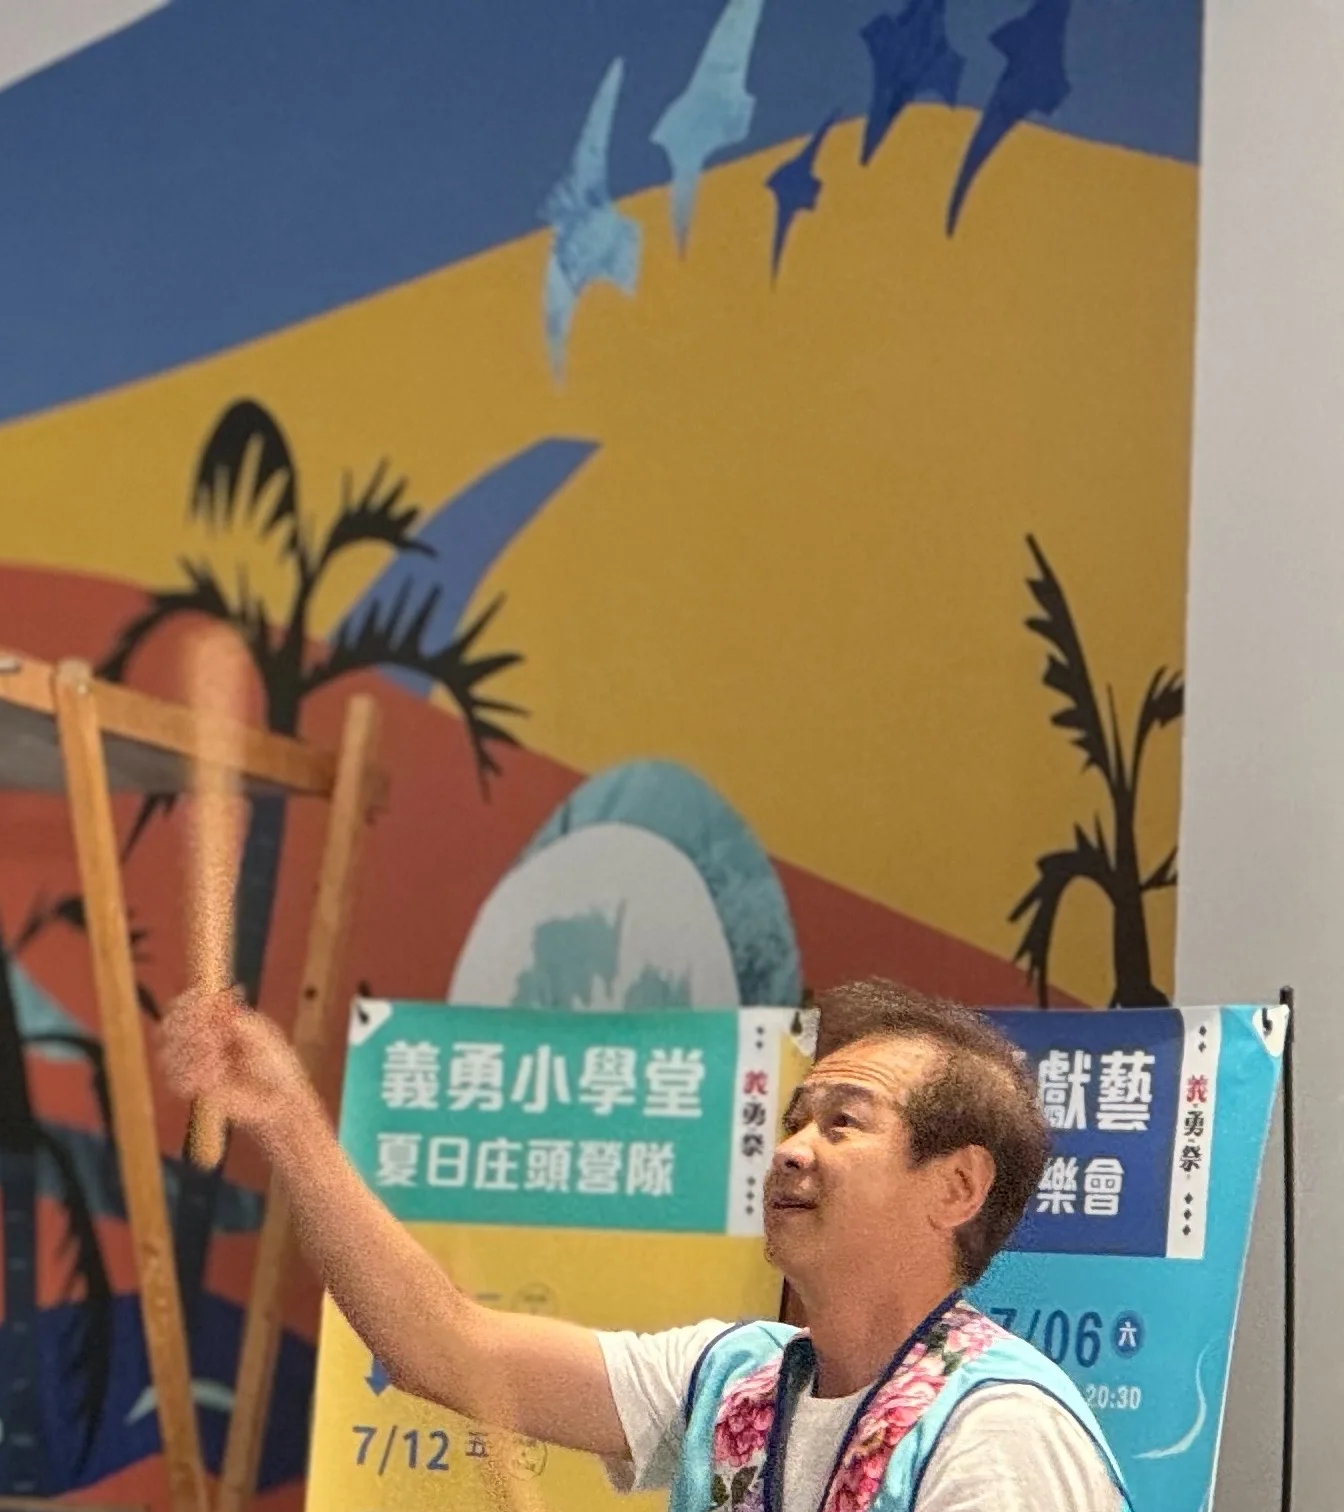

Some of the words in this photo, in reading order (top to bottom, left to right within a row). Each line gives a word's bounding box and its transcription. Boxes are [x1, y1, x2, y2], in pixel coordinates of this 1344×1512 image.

[381, 1040, 706, 1118] 義勇小學堂
[1037, 1050, 1155, 1130] 獻藝
[1179, 1074, 1208, 1173] 義勇祭
[375, 1132, 675, 1197] 夏日庄頭營隊
[1036, 1155, 1124, 1216] 樂會
[352, 1425, 450, 1476] 7/12
[465, 1432, 489, 1458] 五
